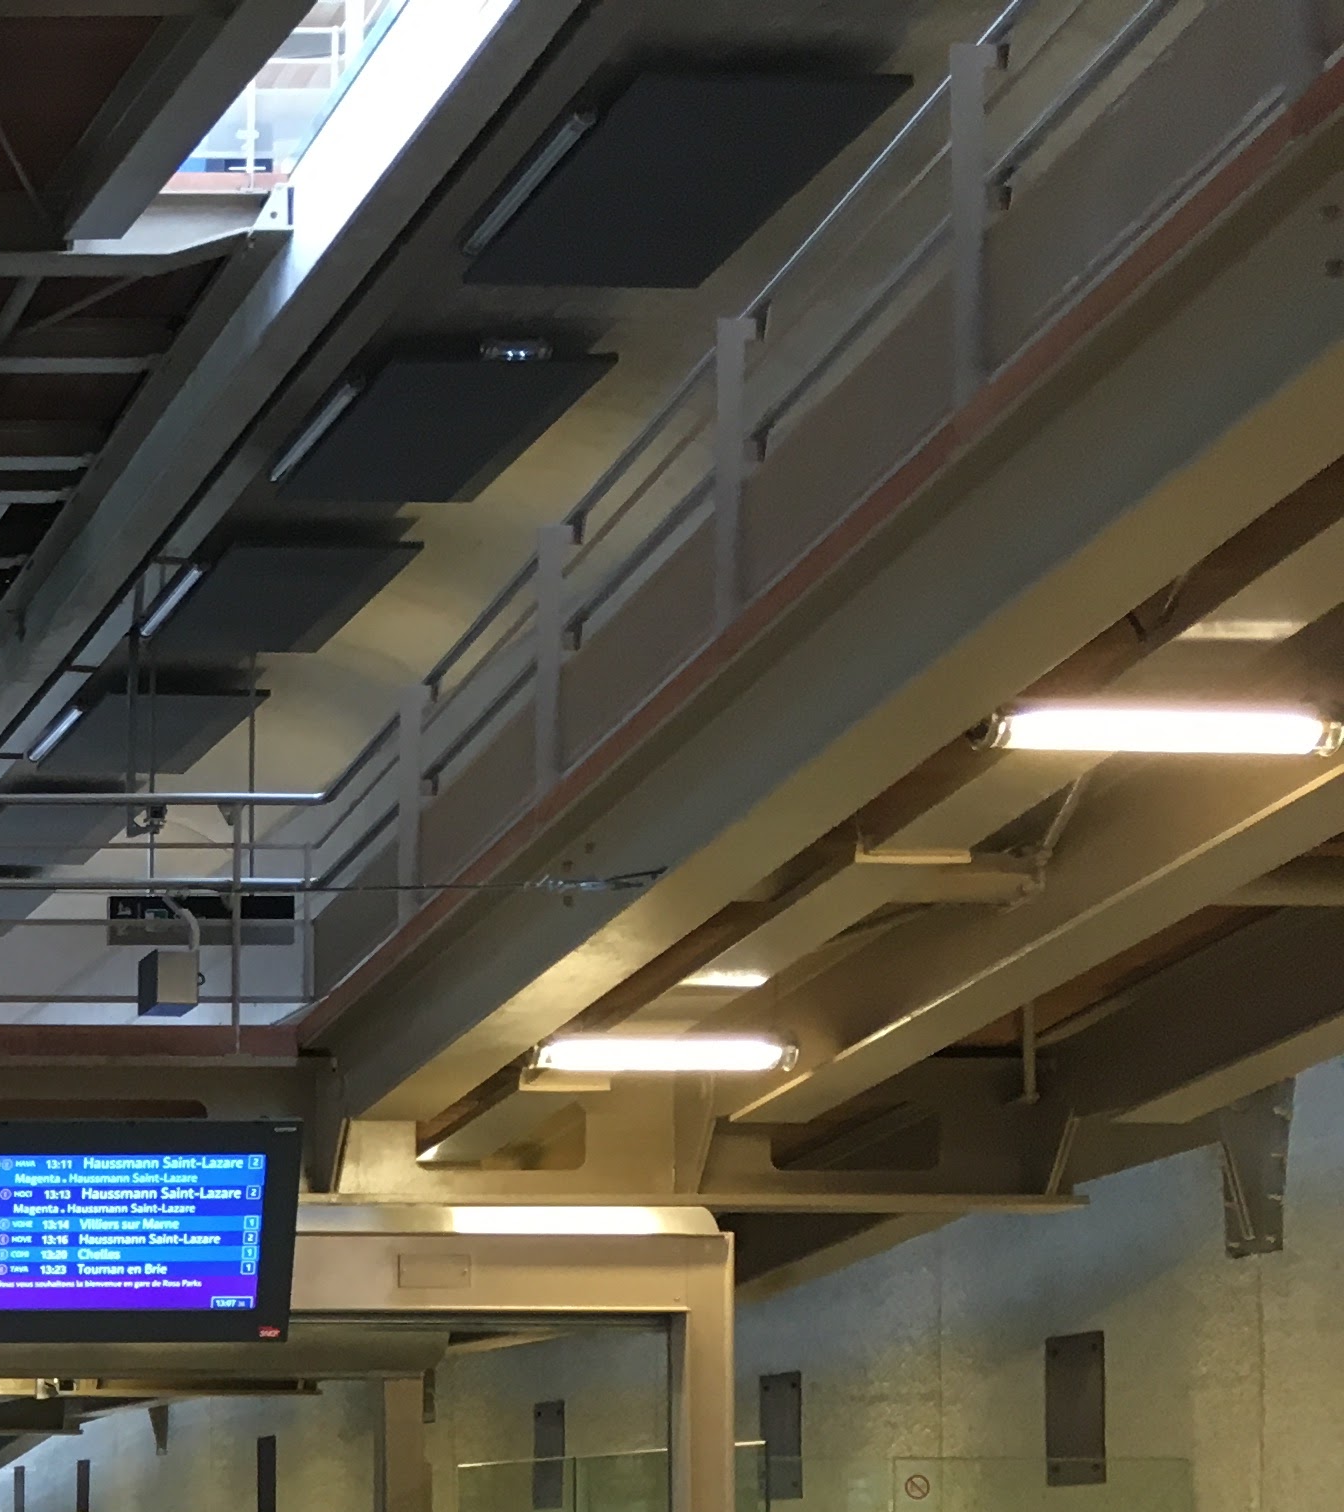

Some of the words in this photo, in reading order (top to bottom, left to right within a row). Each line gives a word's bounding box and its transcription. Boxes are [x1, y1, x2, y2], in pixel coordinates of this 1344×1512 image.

[46, 1159, 72, 1169] 13:11
[84, 1157, 159, 1170] Haussmann
[162, 1156, 243, 1169] Saint-Lazare
[15, 1173, 61, 1185] Magenta
[69, 1173, 130, 1183] Haussmann
[132, 1173, 198, 1184] Saint-Lazare
[44, 1189, 71, 1200] 13:13
[81, 1187, 157, 1200] Haussmann
[160, 1187, 241, 1200] Saint-Lazare
[13, 1203, 59, 1216] Magenta
[67, 1203, 128, 1214] Haussmann
[130, 1203, 196, 1214] Saint-Lazare
[80, 1218, 123, 1230] Villiers
[125, 1220, 140, 1230] sur
[142, 1219, 179, 1230] Marne
[79, 1233, 146, 1245] Haussmann
[148, 1233, 221, 1245] Saint-Lazare
[77, 1249, 121, 1260] Chelles
[40, 1264, 67, 1275] 13:23
[77, 1263, 124, 1275] Tournan
[127, 1266, 142, 1275] en
[144, 1264, 167, 1275] Brie
[162, 1280, 180, 1288] Rosa
[181, 1280, 202, 1288] Parks
